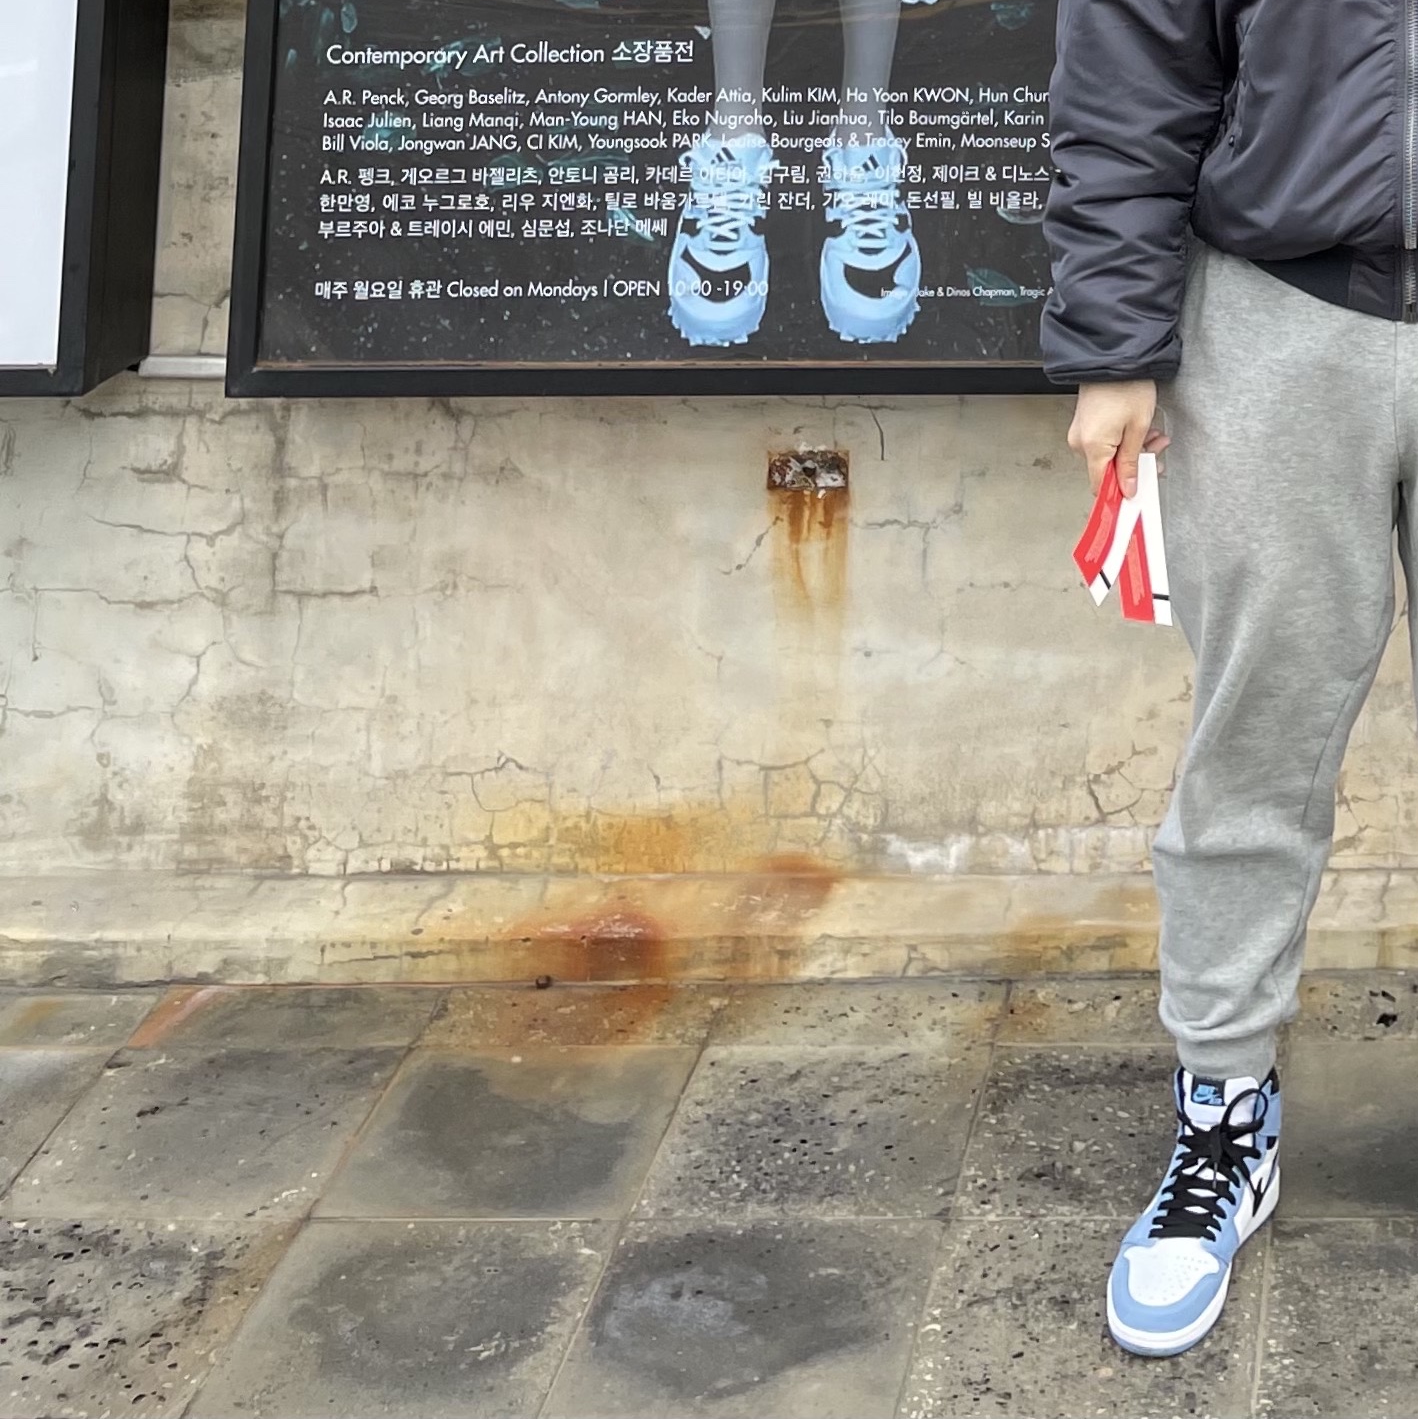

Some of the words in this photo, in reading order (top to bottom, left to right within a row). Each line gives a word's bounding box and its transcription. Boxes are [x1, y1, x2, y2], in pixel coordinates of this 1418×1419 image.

[327, 42, 467, 71] Contemporary
[473, 41, 505, 63] Art
[510, 41, 604, 63] Collection
[612, 40, 693, 63] 소장품전
[323, 90, 356, 105] A.R.
[363, 85, 410, 111] Penck,
[415, 86, 463, 109] Georg
[469, 87, 530, 106] Baselitz,
[535, 89, 590, 108] Antony
[594, 86, 661, 107] Gormley,
[667, 85, 712, 102] Kader
[716, 88, 755, 104] Attia,
[762, 85, 802, 102] Kulim
[808, 87, 840, 104] KIM,
[847, 87, 867, 102] Ha
[873, 88, 908, 102] Yoon
[914, 87, 973, 105] KWON,
[979, 87, 1008, 103] Hun
[324, 113, 363, 128] Isaac
[368, 110, 416, 132] Julien,
[423, 113, 463, 132] Liang
[467, 112, 524, 134] Manqi,
[529, 111, 619, 132] Man-Young
[624, 110, 666, 128] HAN,
[673, 108, 699, 125] Eko
[706, 108, 777, 131] Nugroho,
[784, 110, 803, 125] Liu
[808, 108, 872, 130] Jianhua,
[878, 109, 904, 128] Tilo
[909, 108, 998, 129] Baumgärtel,
[1004, 110, 1044, 125] Karin
[323, 133, 344, 152] Bill
[349, 132, 393, 153] Viola,
[398, 134, 467, 155] Jongwan
[468, 133, 521, 152] JANG,
[527, 134, 543, 150] CI
[548, 134, 582, 151] KIM,
[588, 129, 667, 153] Youngsook
[772, 131, 842, 153] Bourgeois
[848, 133, 859, 148] &
[865, 133, 911, 153] Tracey
[916, 133, 955, 150] Emin,
[961, 133, 1036, 152] Moonseup
[1041, 131, 1050, 148] S
[320, 167, 351, 184] A.R.
[401, 167, 467, 189] 게오르그
[472, 166, 542, 187] 바젤리츠,
[548, 164, 597, 184] 안토니
[603, 164, 639, 184] 곰리,
[645, 165, 694, 185] 카데르
[932, 164, 980, 183] 제이크
[984, 165, 997, 181] &
[1002, 165, 1050, 183] 디노스
[320, 190, 375, 212] 한만영,
[383, 194, 416, 212] 에코
[422, 190, 495, 212] 누그로호,
[503, 193, 535, 214] 리우
[542, 192, 597, 211] 지엔화,
[605, 192, 638, 210] 틸로
[778, 191, 815, 210] 잔더,
[905, 191, 959, 213] 돈선필,
[968, 189, 982, 209] 빌
[990, 191, 1042, 212] 비올라,
[318, 220, 385, 239] 부르주아
[390, 221, 402, 236] &
[407, 219, 472, 238] 트레이시
[479, 219, 514, 238] 에민,
[521, 219, 574, 237] 심문섭,
[580, 219, 630, 237] 조나단
[636, 218, 668, 238] 메쎄
[315, 281, 348, 299] 매주
[353, 280, 402, 300] 월요일
[408, 280, 442, 299] 휴관
[447, 279, 499, 297] Closed
[503, 286, 522, 297] on
[528, 278, 598, 303] Mondays
[612, 278, 660, 296] OPEN
[946, 287, 971, 297] Dinos
[972, 287, 1018, 298] Chapman,
[1020, 287, 1045, 299] Tragic
